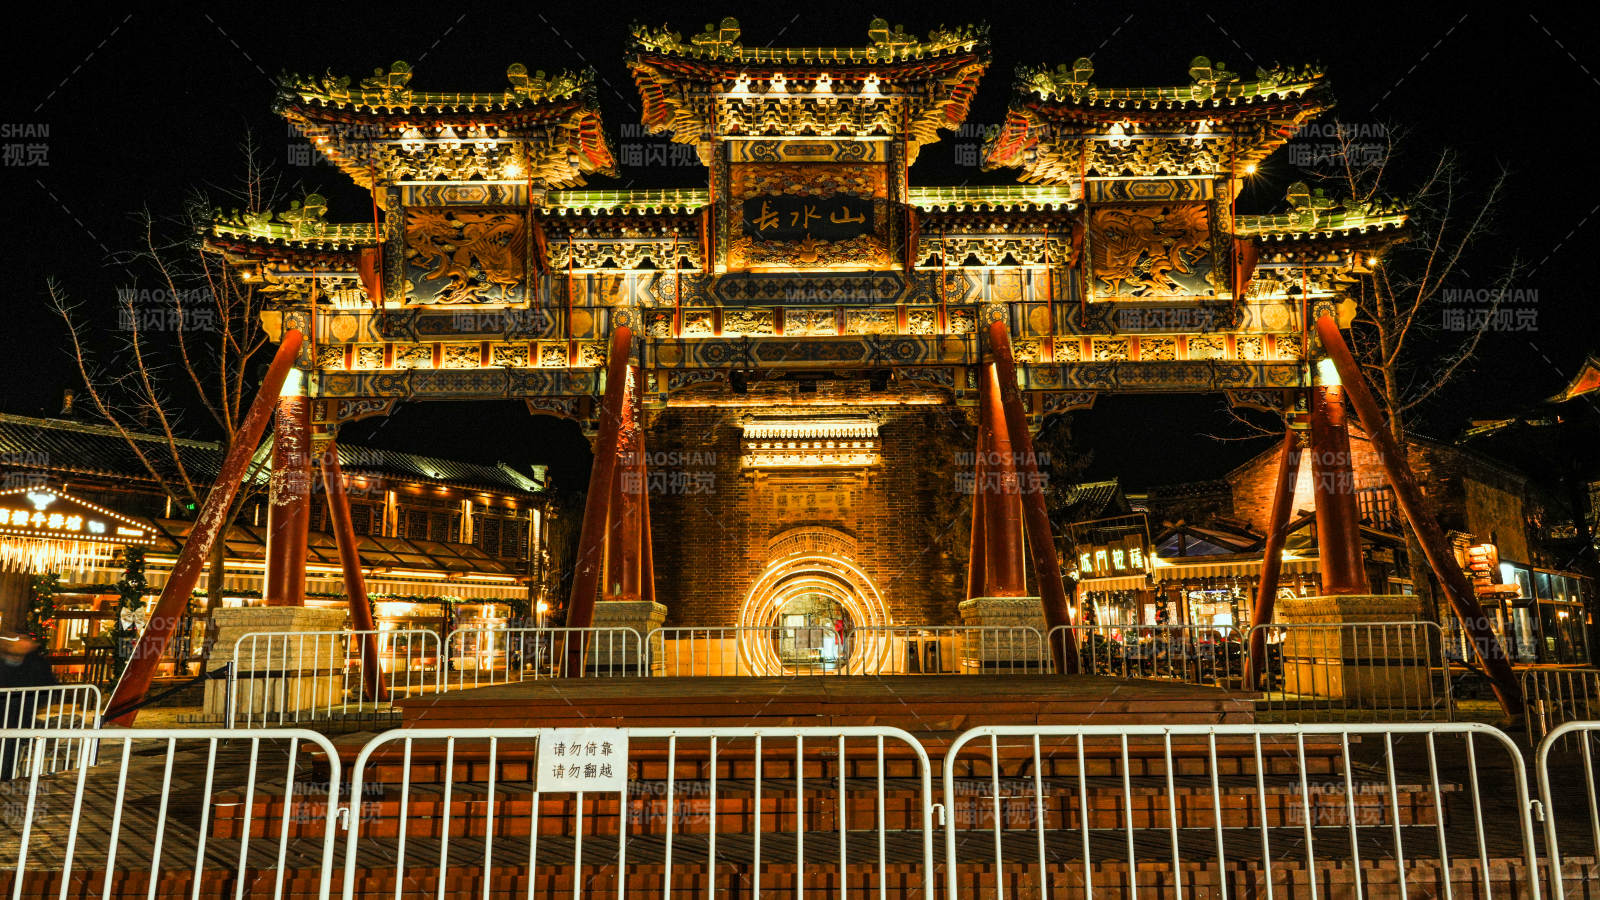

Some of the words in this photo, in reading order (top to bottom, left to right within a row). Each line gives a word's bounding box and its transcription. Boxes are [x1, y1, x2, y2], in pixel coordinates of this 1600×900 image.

[553, 741, 614, 757] 请勿倚靠
[551, 763, 613, 779] 请勿翻越
